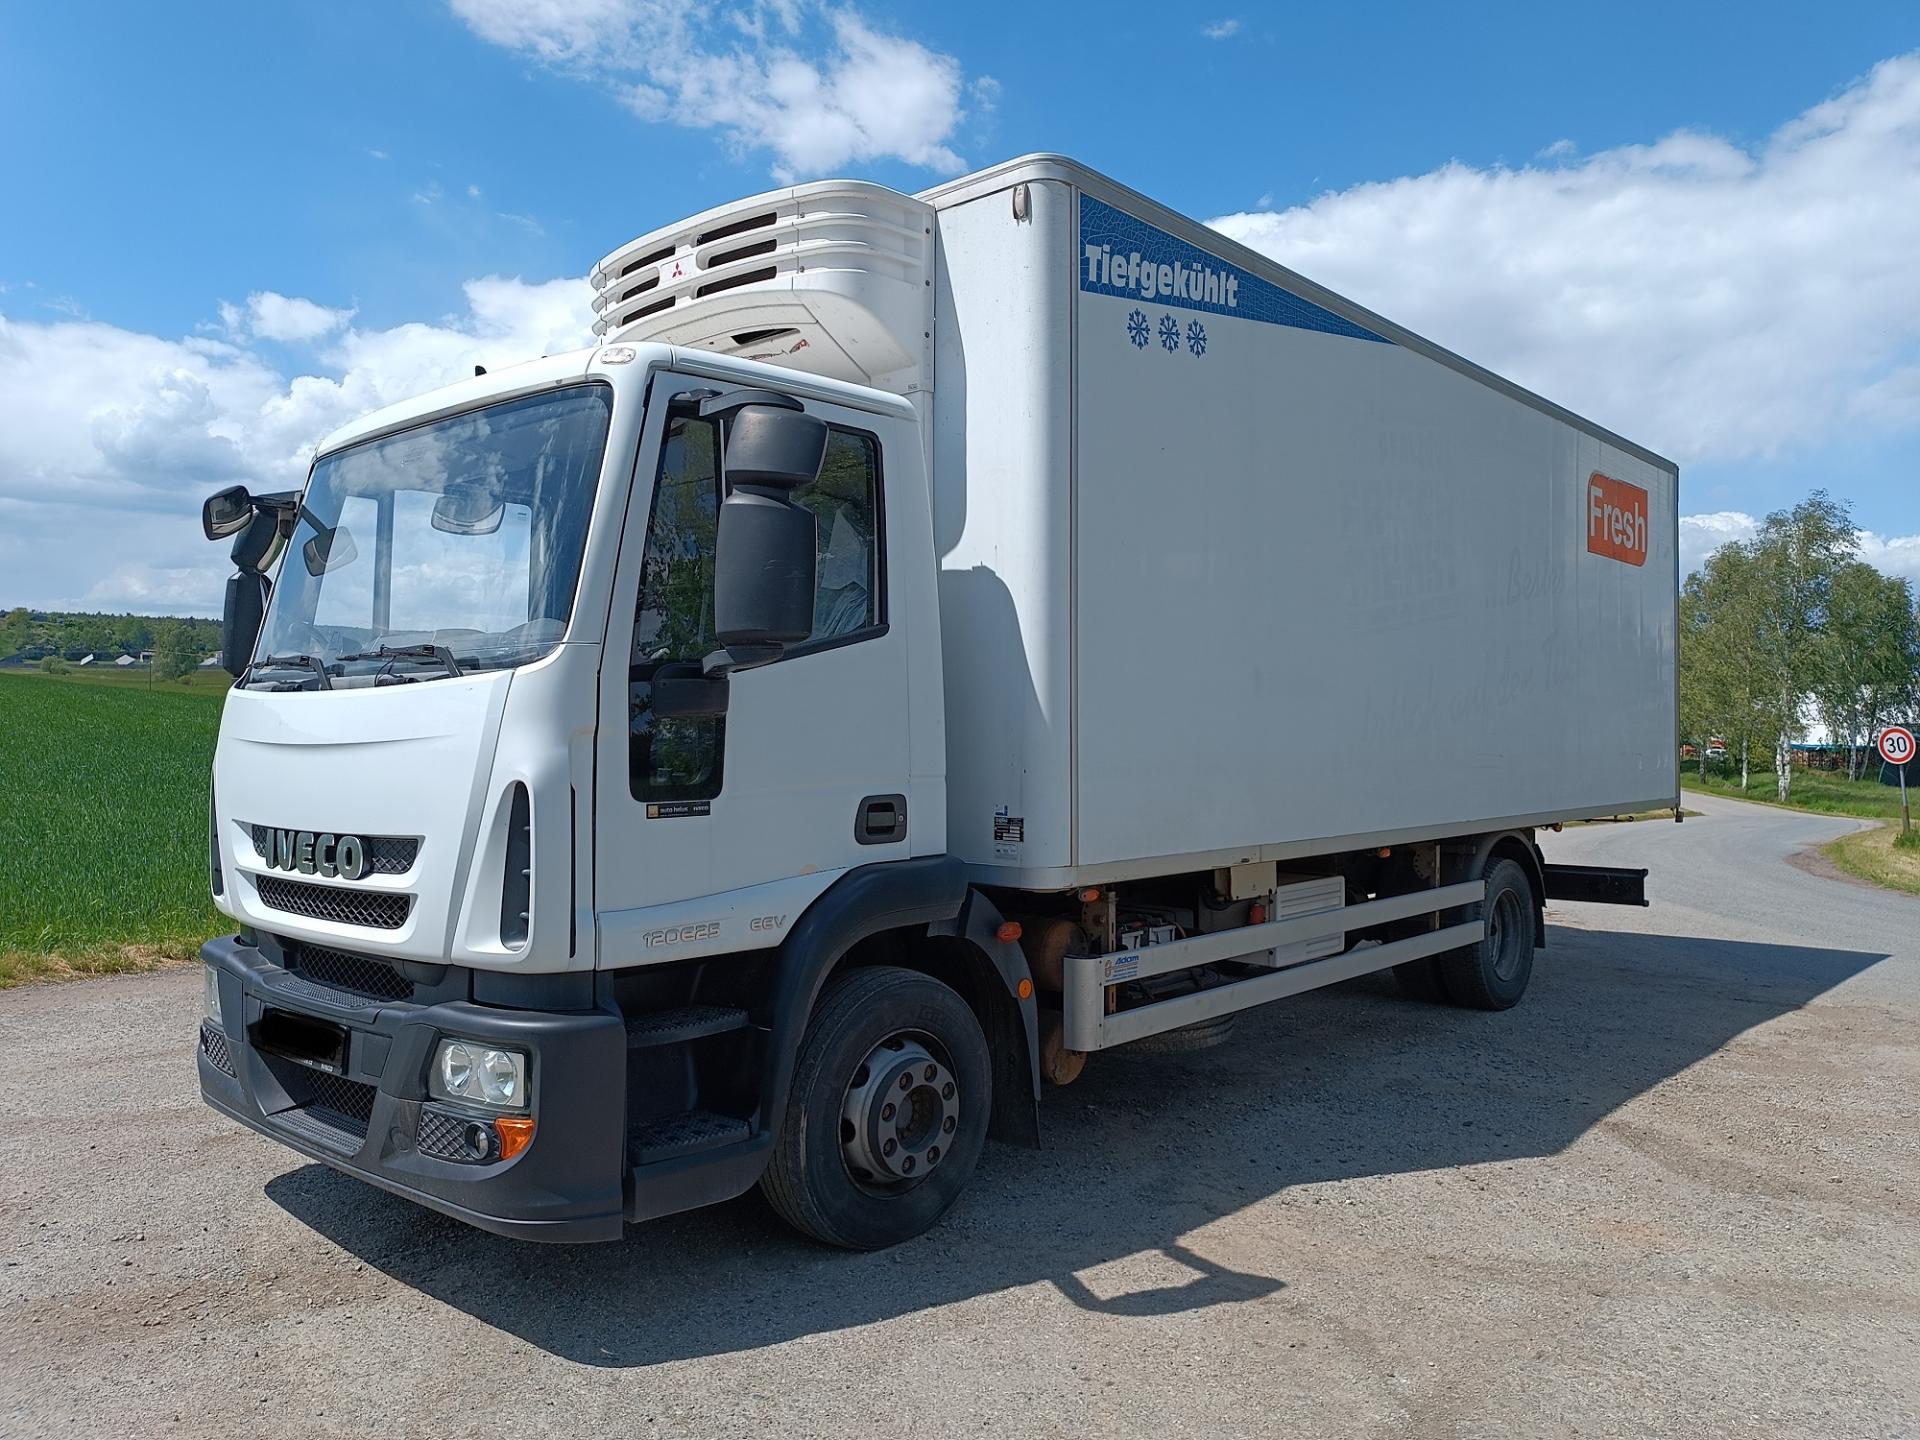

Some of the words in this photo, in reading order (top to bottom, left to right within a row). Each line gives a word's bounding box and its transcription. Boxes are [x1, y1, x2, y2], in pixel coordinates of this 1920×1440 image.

[1085, 243, 1239, 307] Tiefgekühlt
[1590, 485, 1646, 553] Fresh
[1885, 736, 1908, 753] 30
[265, 828, 369, 880] IVECO
[642, 922, 721, 949] 120E25
[750, 914, 787, 932] EEV
[1115, 955, 1139, 964] Adam
